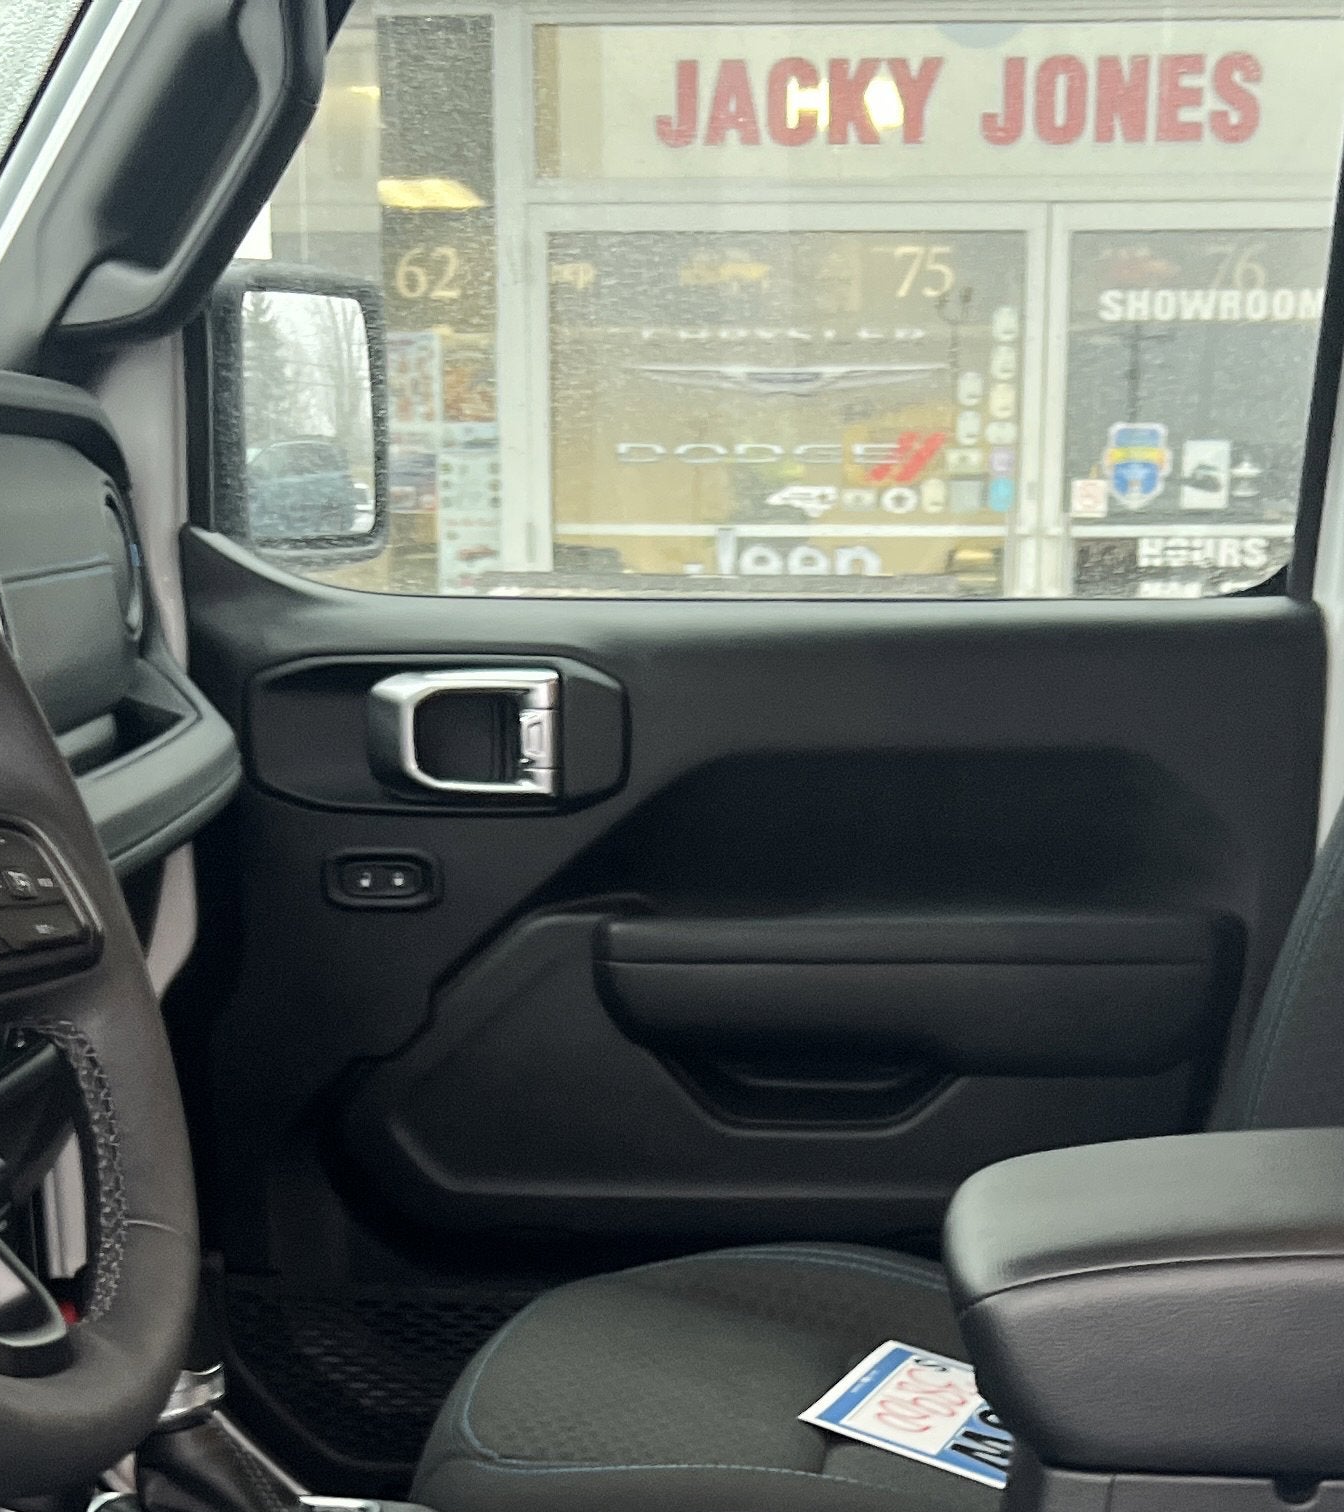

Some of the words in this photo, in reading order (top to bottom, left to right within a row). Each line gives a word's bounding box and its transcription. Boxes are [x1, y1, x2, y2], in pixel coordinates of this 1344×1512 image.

[656, 56, 945, 148] JACKY
[981, 51, 1264, 145] JONES
[395, 247, 460, 299] 62
[893, 245, 955, 298] 75
[615, 442, 901, 464] DODGE
